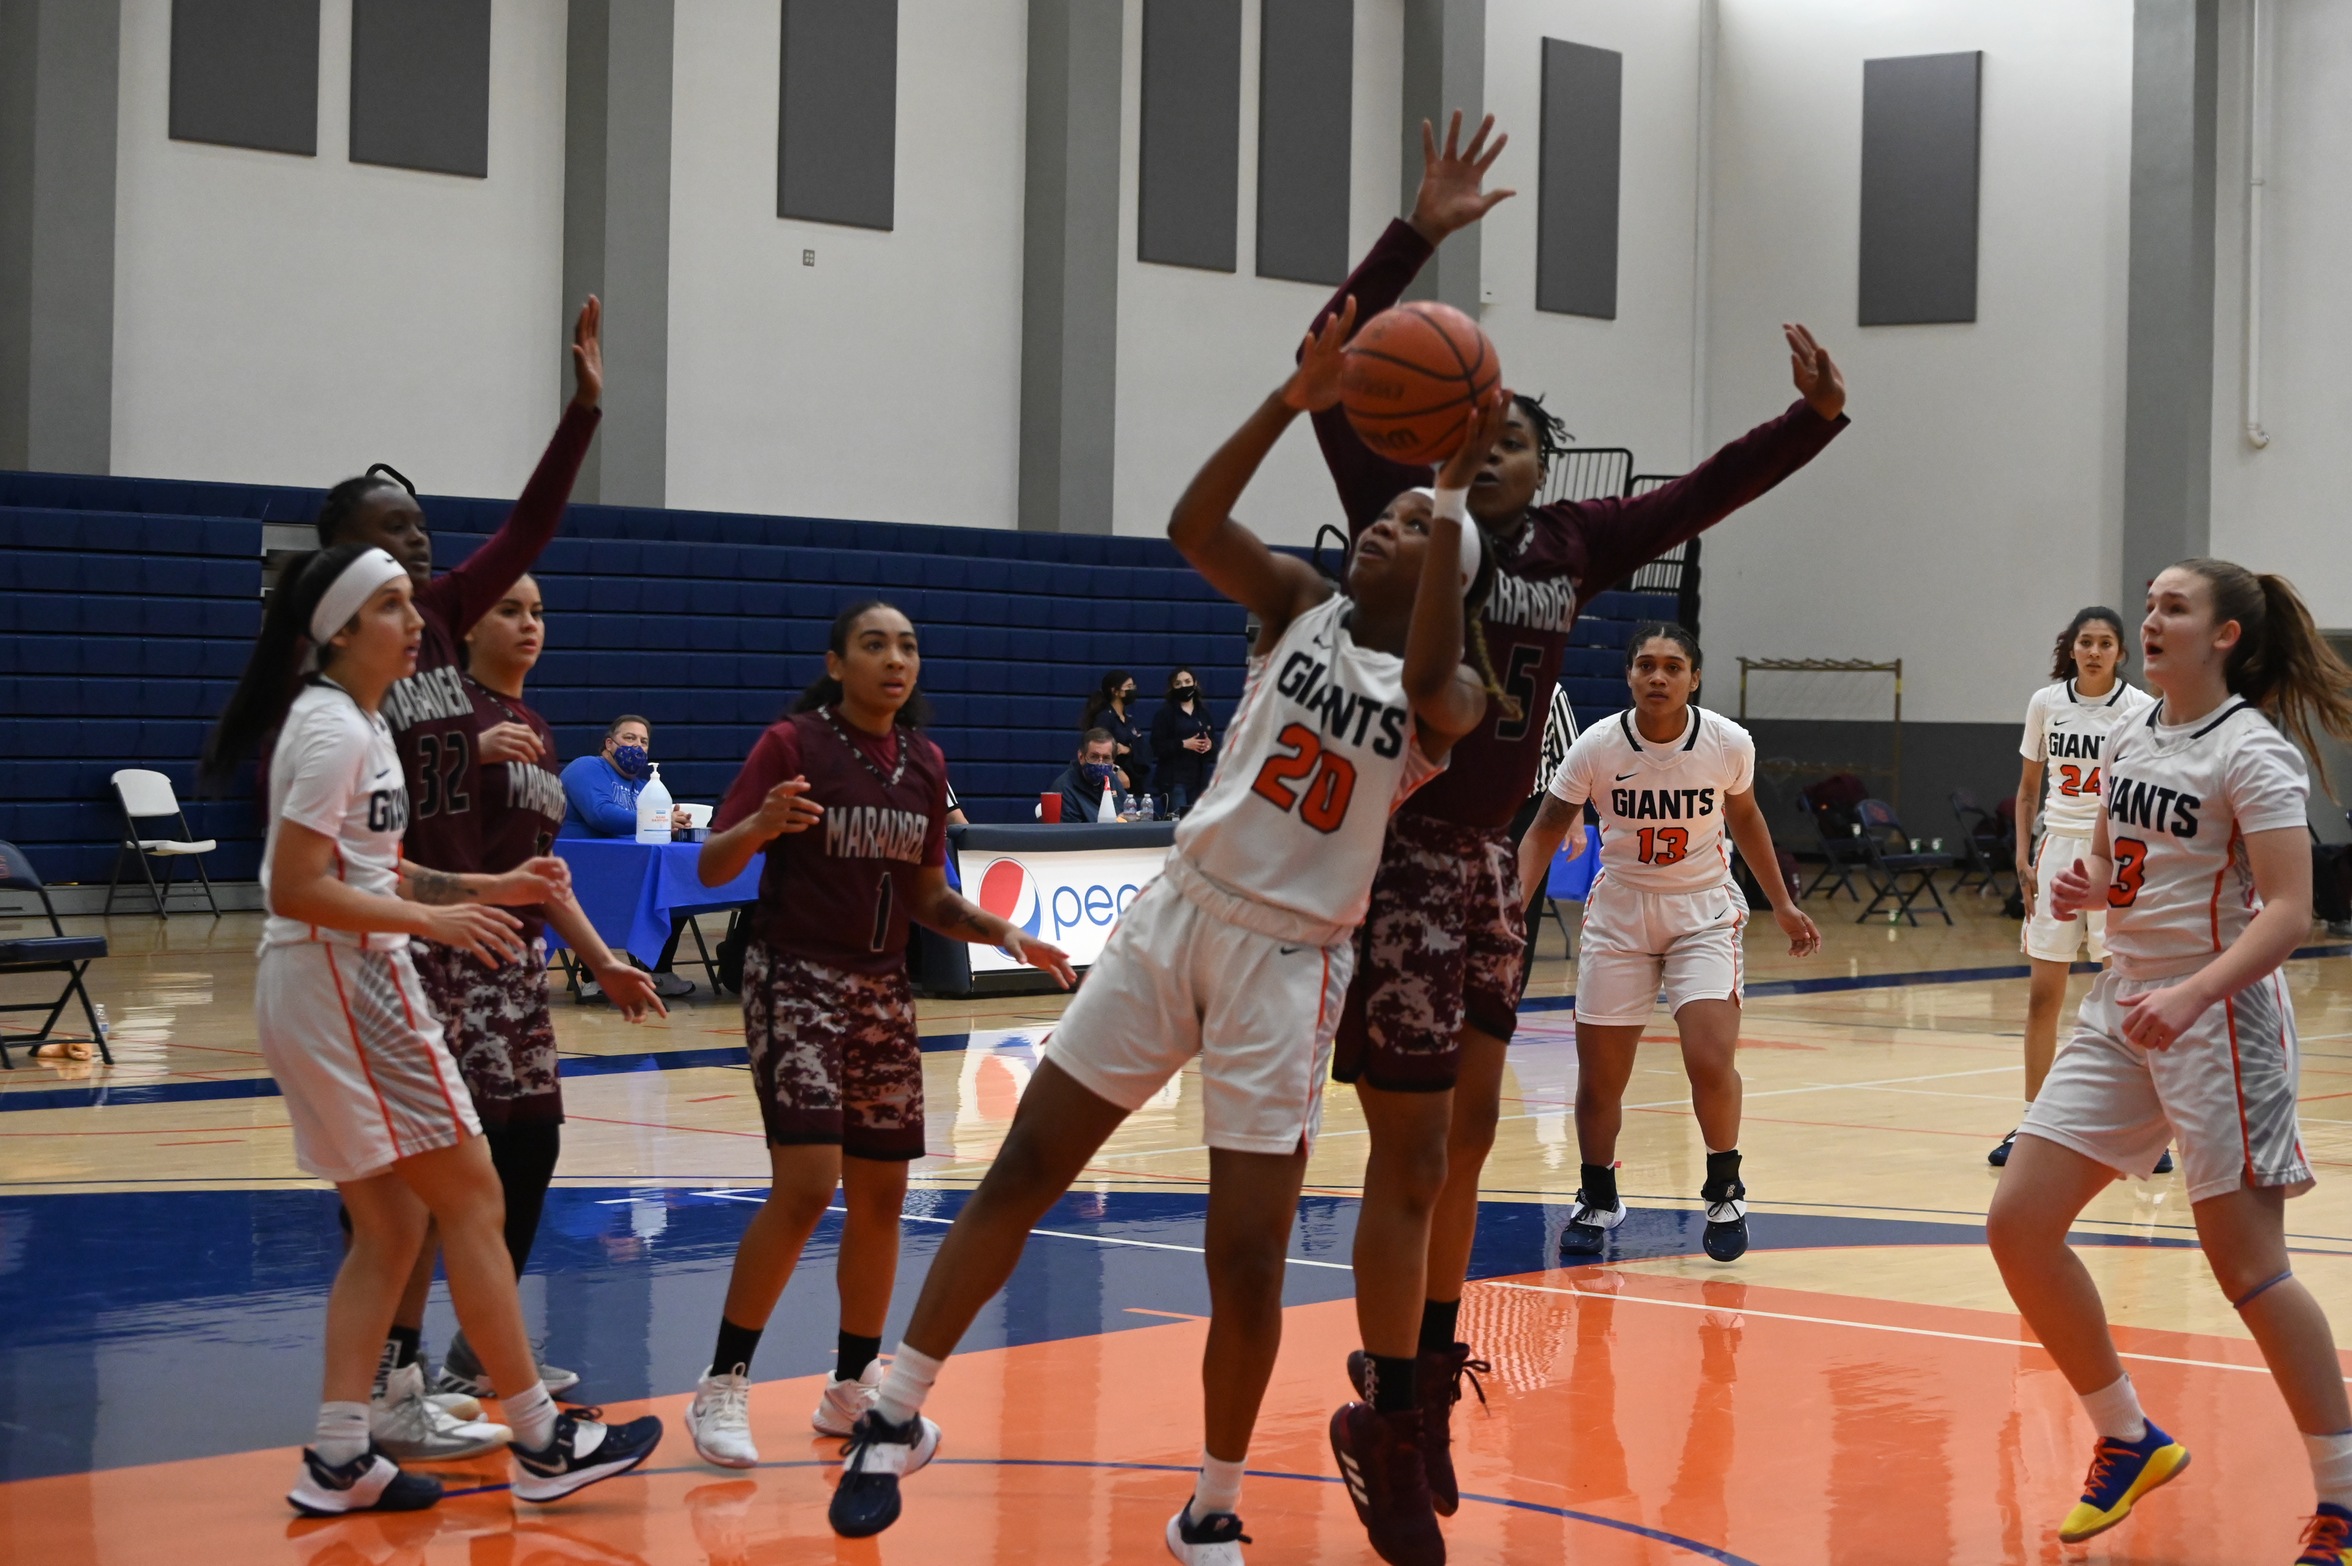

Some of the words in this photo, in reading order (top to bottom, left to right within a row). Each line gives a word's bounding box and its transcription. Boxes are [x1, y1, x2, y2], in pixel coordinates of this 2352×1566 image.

[1277, 651, 1406, 759] GIANTS
[1495, 643, 1544, 741] 5
[418, 730, 470, 820] 32
[1252, 722, 1356, 834] 20
[2049, 733, 2105, 760] GIAN
[2059, 765, 2101, 797] 24
[1611, 788, 1715, 819] GIANTS
[2108, 776, 2201, 838] IANTS
[1637, 827, 1689, 865] 13
[2107, 836, 2148, 908] 3
[870, 872, 893, 952] 1
